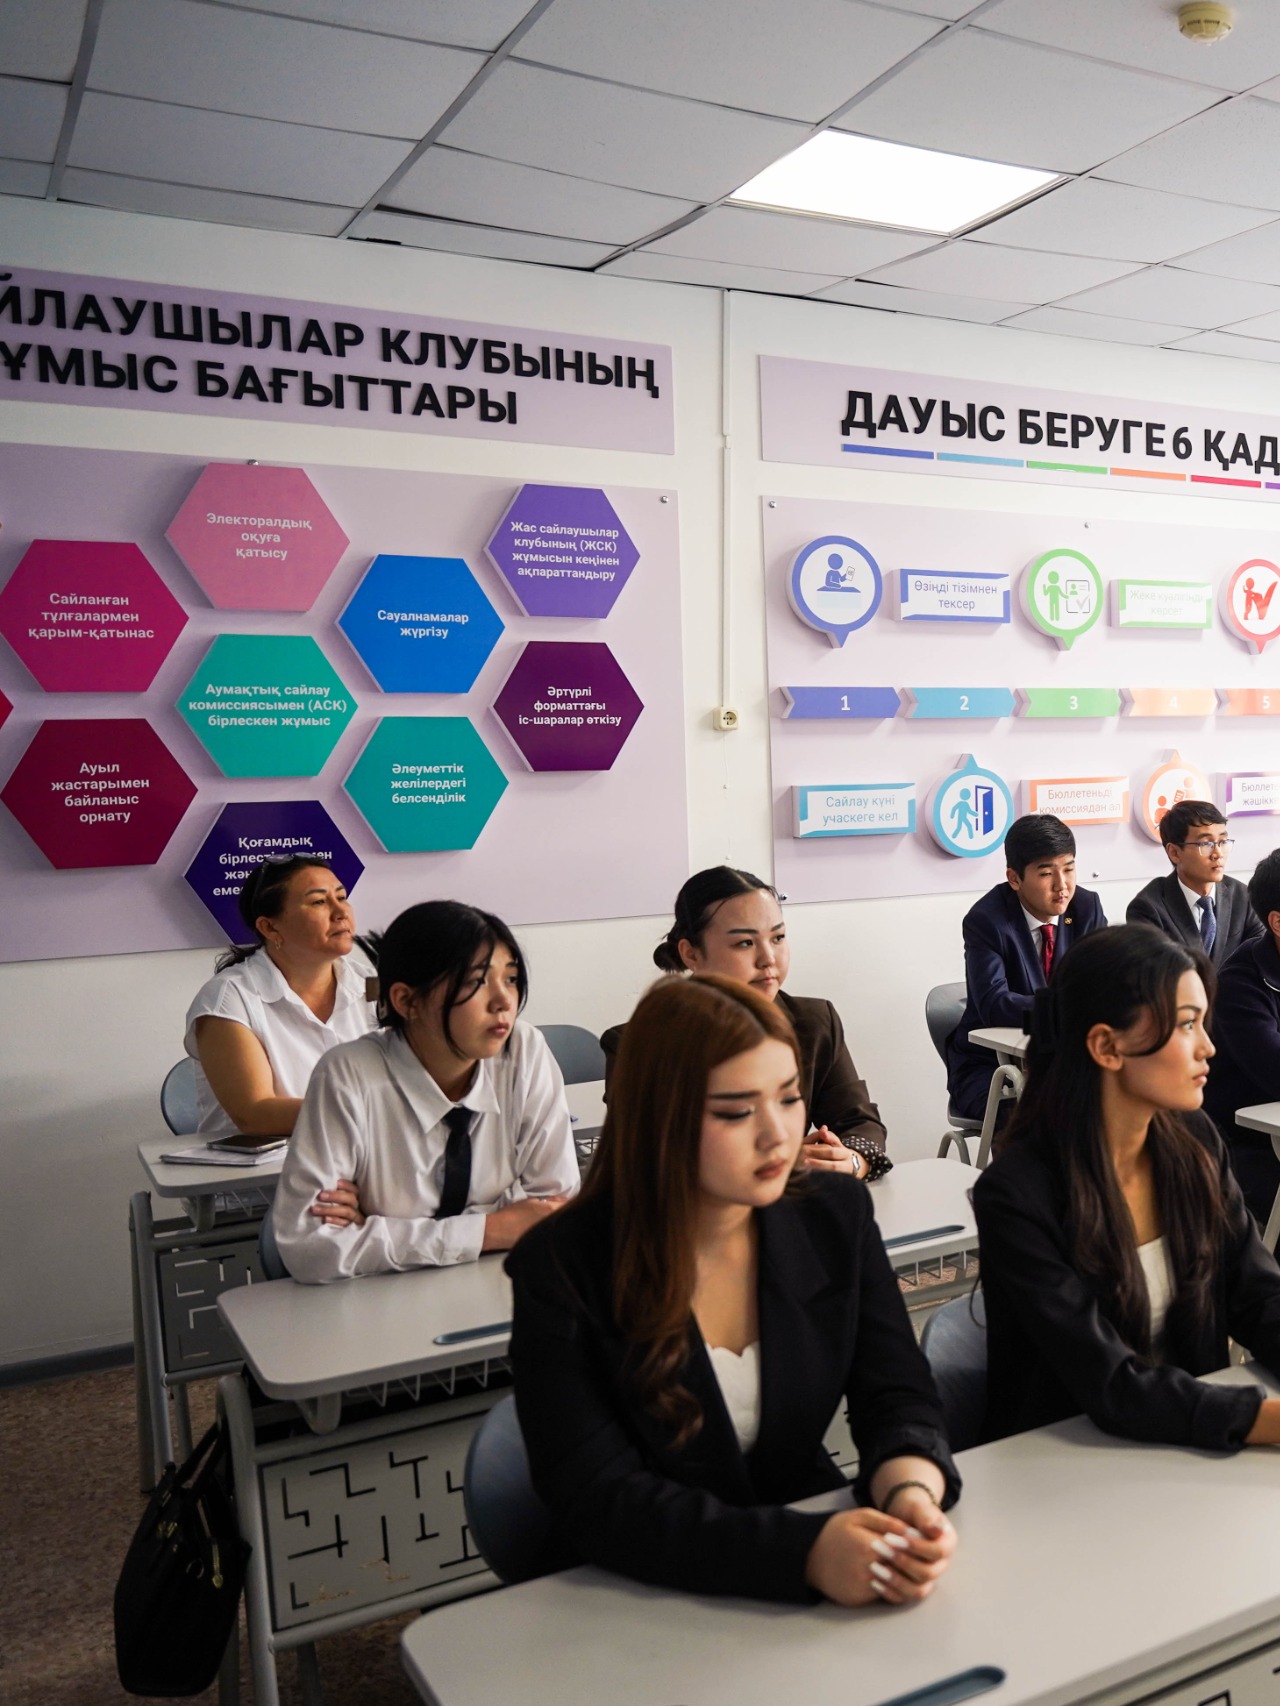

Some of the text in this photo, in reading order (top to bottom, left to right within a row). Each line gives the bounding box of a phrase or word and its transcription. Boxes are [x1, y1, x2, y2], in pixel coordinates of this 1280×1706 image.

[381, 327, 660, 399] КЛУБЫНЫҢ
[196, 360, 518, 425] БАҒЫТТАРЫ
[840, 389, 1006, 442] ДАУЫС
[1018, 408, 1167, 458] БЕРУГЕ
[1171, 426, 1193, 460] 6
[206, 512, 313, 531] Электоралдық
[510, 521, 619, 539] Жас сайлаушылар
[241, 531, 281, 545] оқуға
[514, 536, 618, 553] клубының (ЖСК)
[235, 546, 288, 561] қатысу
[512, 551, 620, 567] жұмысын кеңінен
[517, 566, 616, 582] ақпараттандыру
[914, 580, 998, 594] Өзіңді тізімнен
[49, 592, 130, 606] Сайланған
[938, 599, 976, 611] тексер
[41, 610, 140, 623] тұлғалармен
[377, 609, 469, 625] Сауалнамалар
[28, 627, 155, 640] қарым-қатынас
[400, 626, 449, 639] жүргізу
[205, 683, 331, 698] Аумақтық сайлау
[547, 686, 592, 699] Әртүрлі
[188, 699, 348, 713] комиссиясымен (АСК)
[534, 700, 606, 713] форматтағы
[840, 695, 851, 711] 1
[959, 695, 970, 711] 2
[1069, 695, 1079, 710] 3
[1168, 696, 1179, 710] 4
[1262, 696, 1271, 709] 5
[208, 714, 331, 729] бірлескен жұмыс
[518, 714, 622, 727] іс-шаралар өткізу
[79, 762, 120, 776] Ауыл
[392, 763, 464, 776] Әлеуметтік
[51, 778, 150, 793] жастарымен
[390, 778, 467, 792] желілердегі
[64, 793, 140, 808] байланыс
[391, 792, 467, 805] белсенділік
[1047, 788, 1113, 800] Бюллетеньді
[826, 794, 895, 809] Сайлау күні
[1039, 803, 1107, 815] комиссиядан
[79, 810, 131, 825] орнату
[822, 811, 898, 827] учаскеге кел
[238, 836, 313, 850] Қоғамдық
[212, 886, 244, 896] еме
